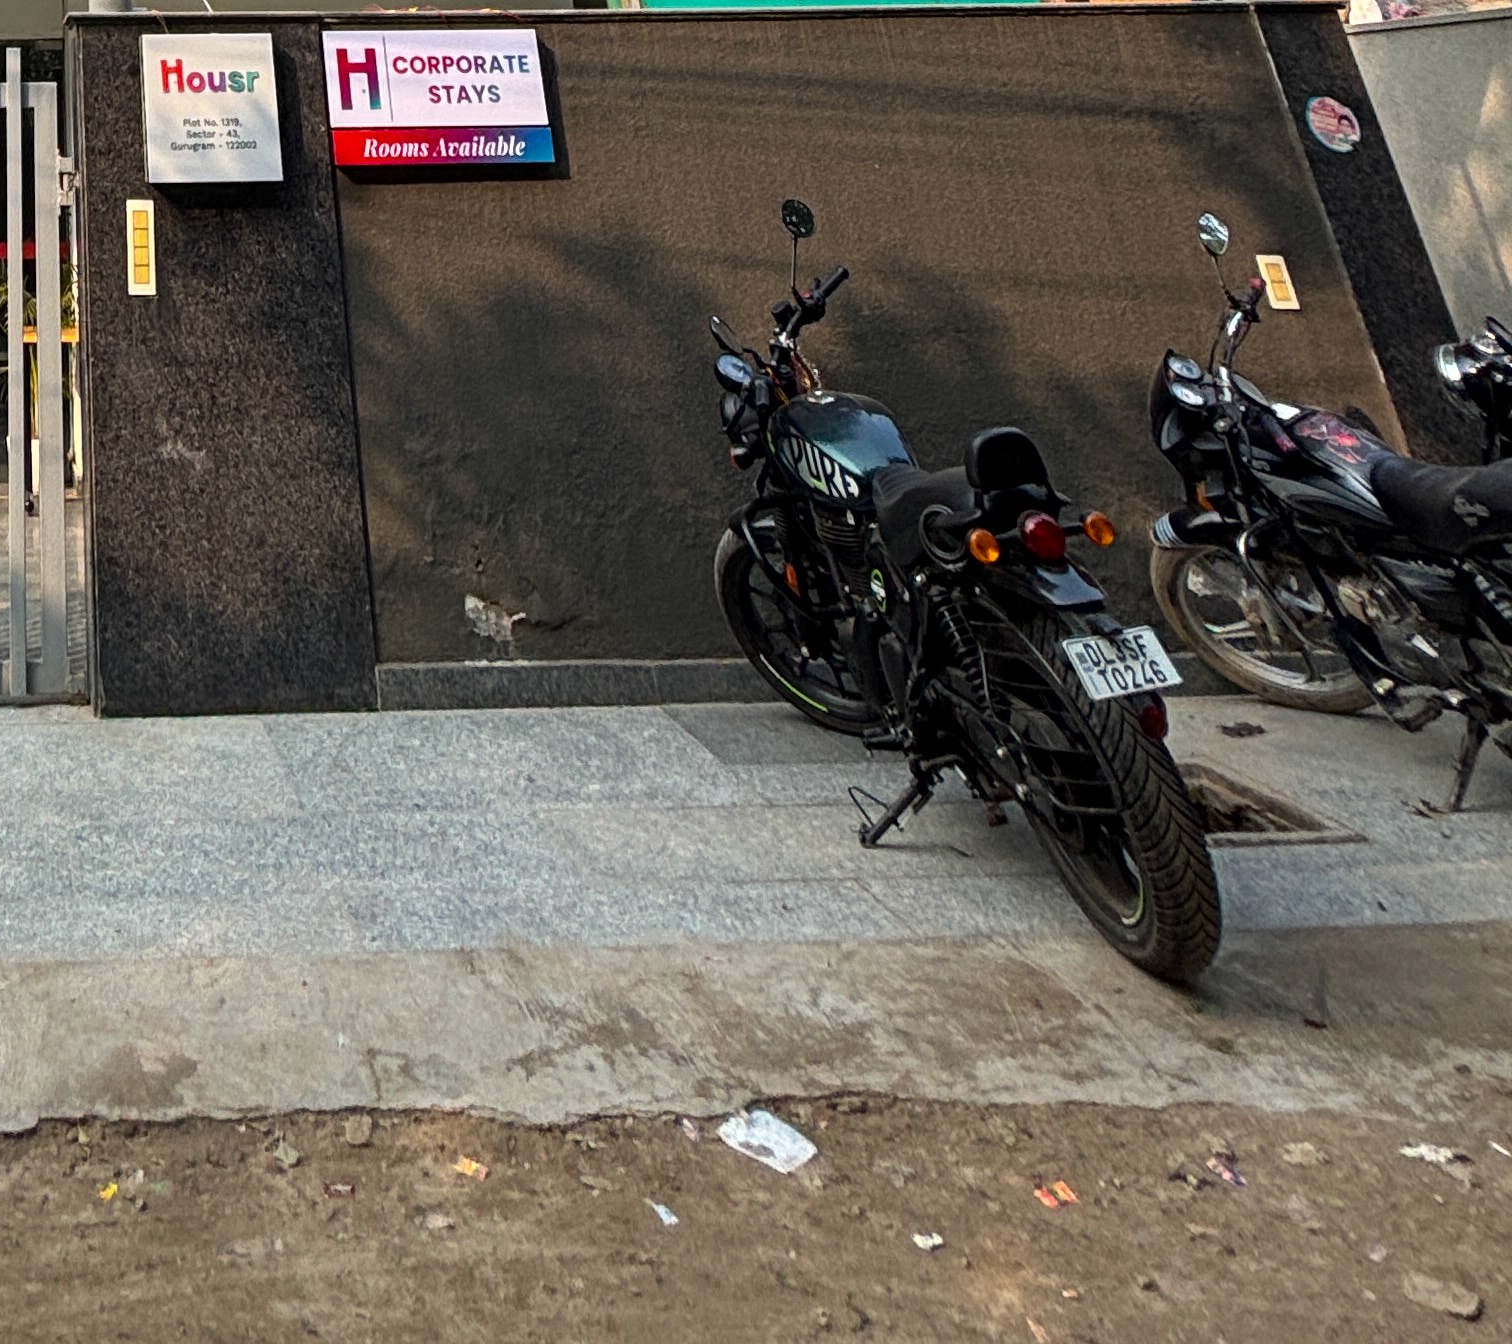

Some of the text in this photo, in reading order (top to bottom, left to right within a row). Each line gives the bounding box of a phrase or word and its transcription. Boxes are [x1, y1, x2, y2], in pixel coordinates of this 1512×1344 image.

[392, 54, 531, 75] CORPORATE
[160, 59, 260, 94] Housr
[335, 48, 382, 111] H
[427, 85, 501, 104] STAYS
[183, 118, 201, 127] Plot
[186, 130, 215, 139] Sector
[170, 141, 215, 152] Gurugram
[364, 132, 526, 158] Rooms Available
